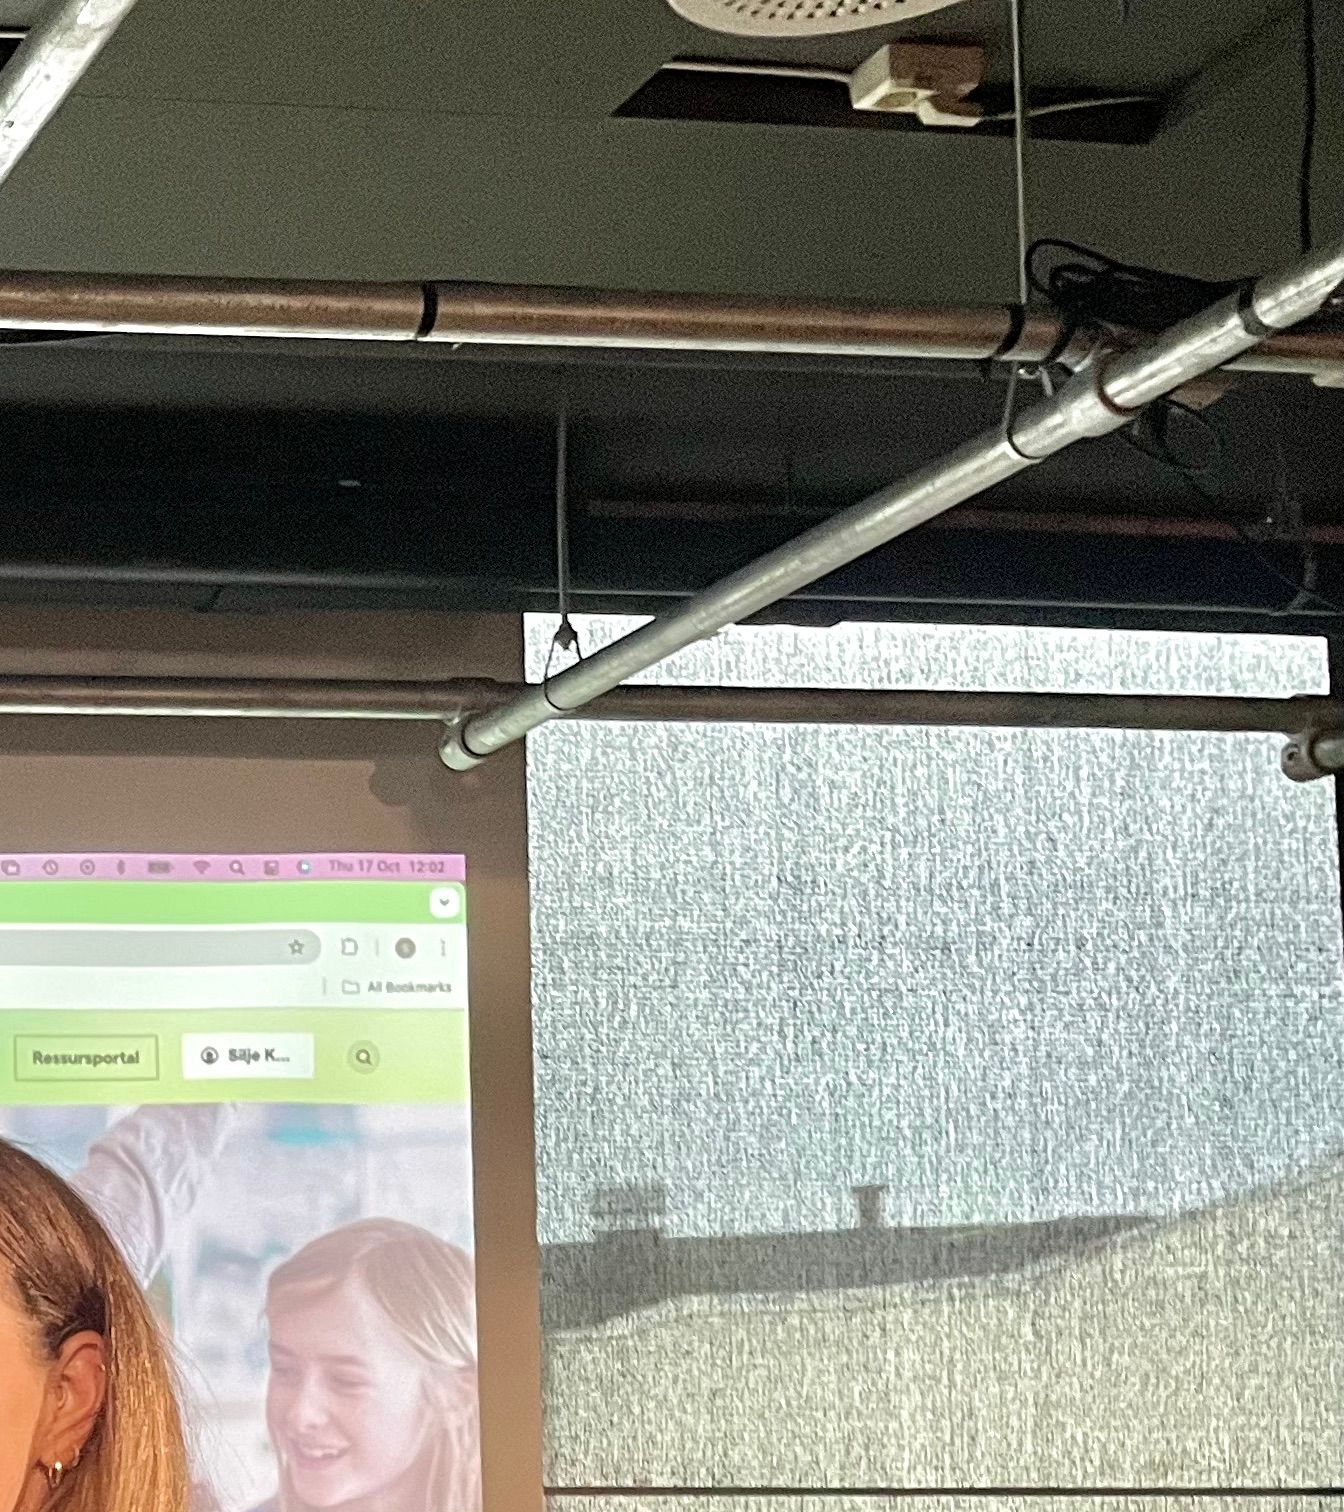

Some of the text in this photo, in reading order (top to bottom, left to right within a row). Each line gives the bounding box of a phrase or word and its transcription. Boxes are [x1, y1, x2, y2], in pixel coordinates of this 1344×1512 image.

[329, 859, 354, 872] Thu
[358, 859, 373, 872] 17
[377, 860, 401, 873] Oct
[367, 980, 452, 993] All Bookmarks
[32, 1050, 140, 1067] Ressursportal
[228, 1048, 261, 1065] Silje
